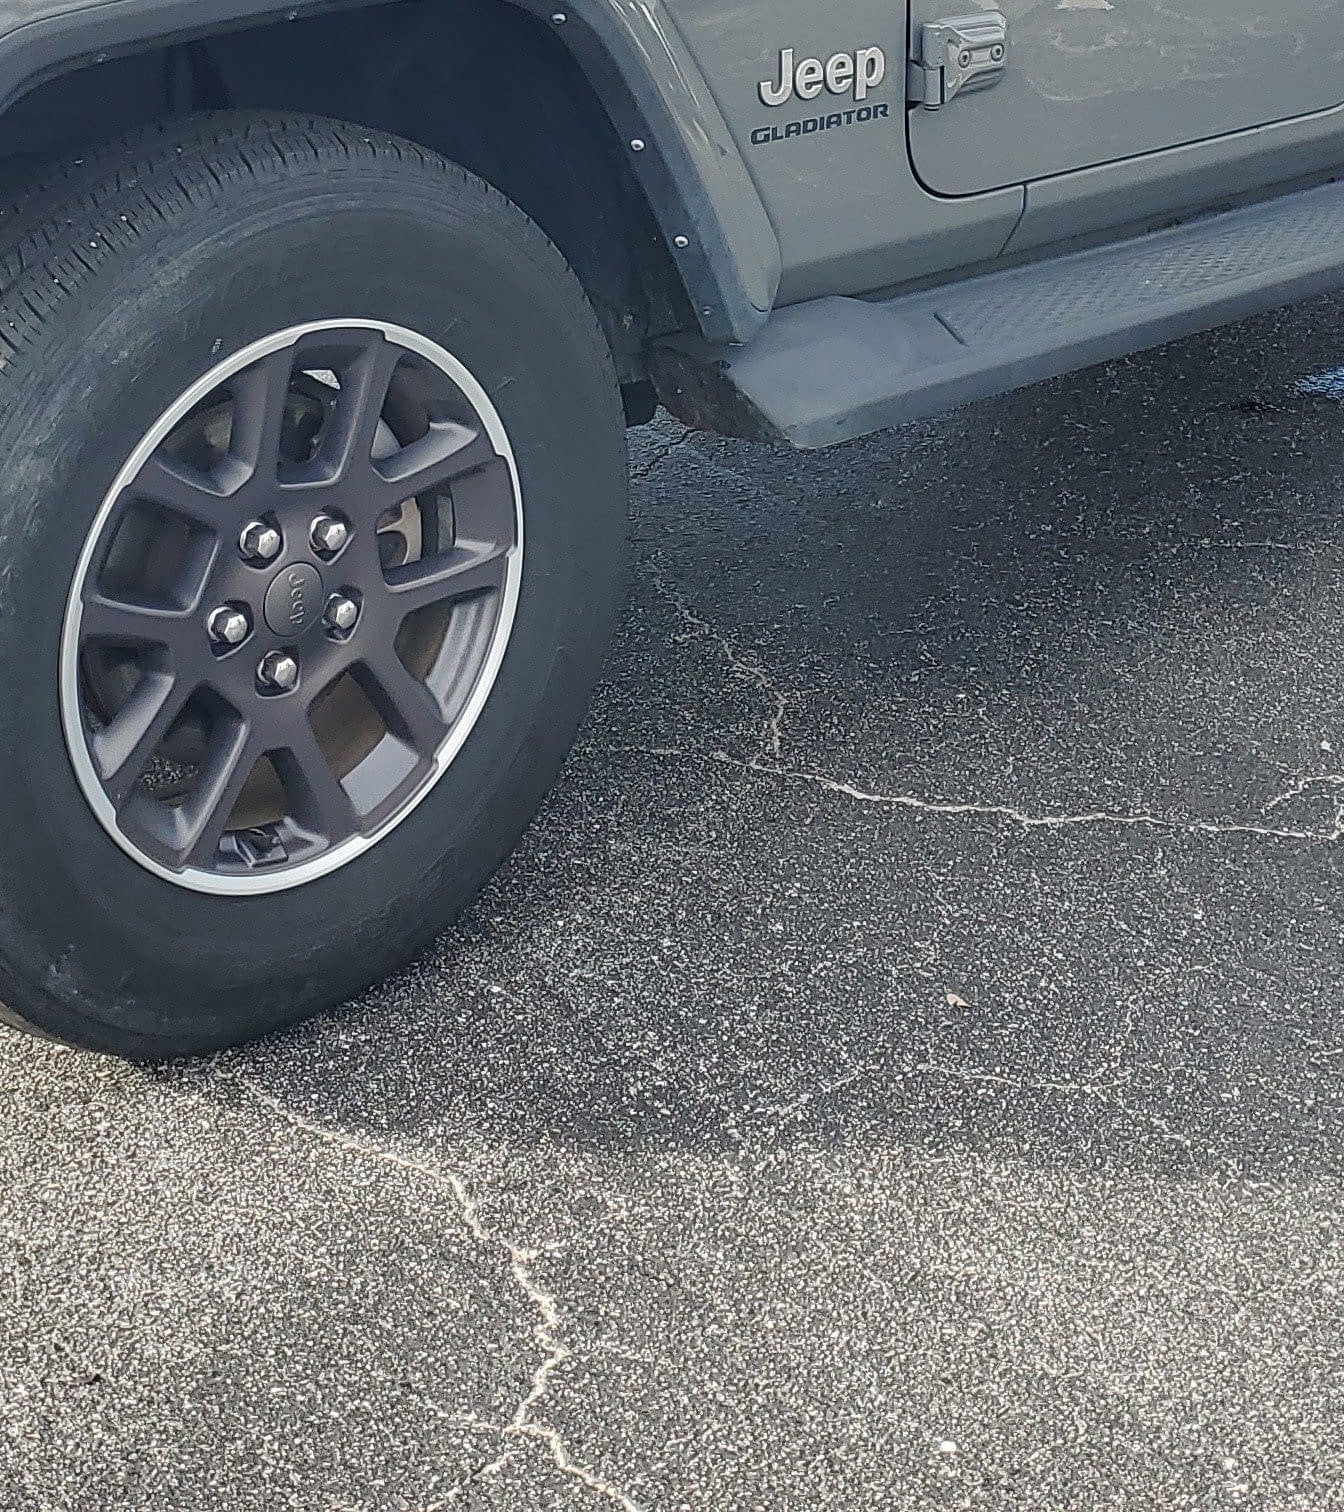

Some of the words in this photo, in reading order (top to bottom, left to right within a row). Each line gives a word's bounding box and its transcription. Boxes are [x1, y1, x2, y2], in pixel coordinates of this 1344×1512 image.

[758, 46, 886, 107] Jeep
[750, 103, 890, 146] GLADIATOR
[288, 573, 305, 625] Jeep
